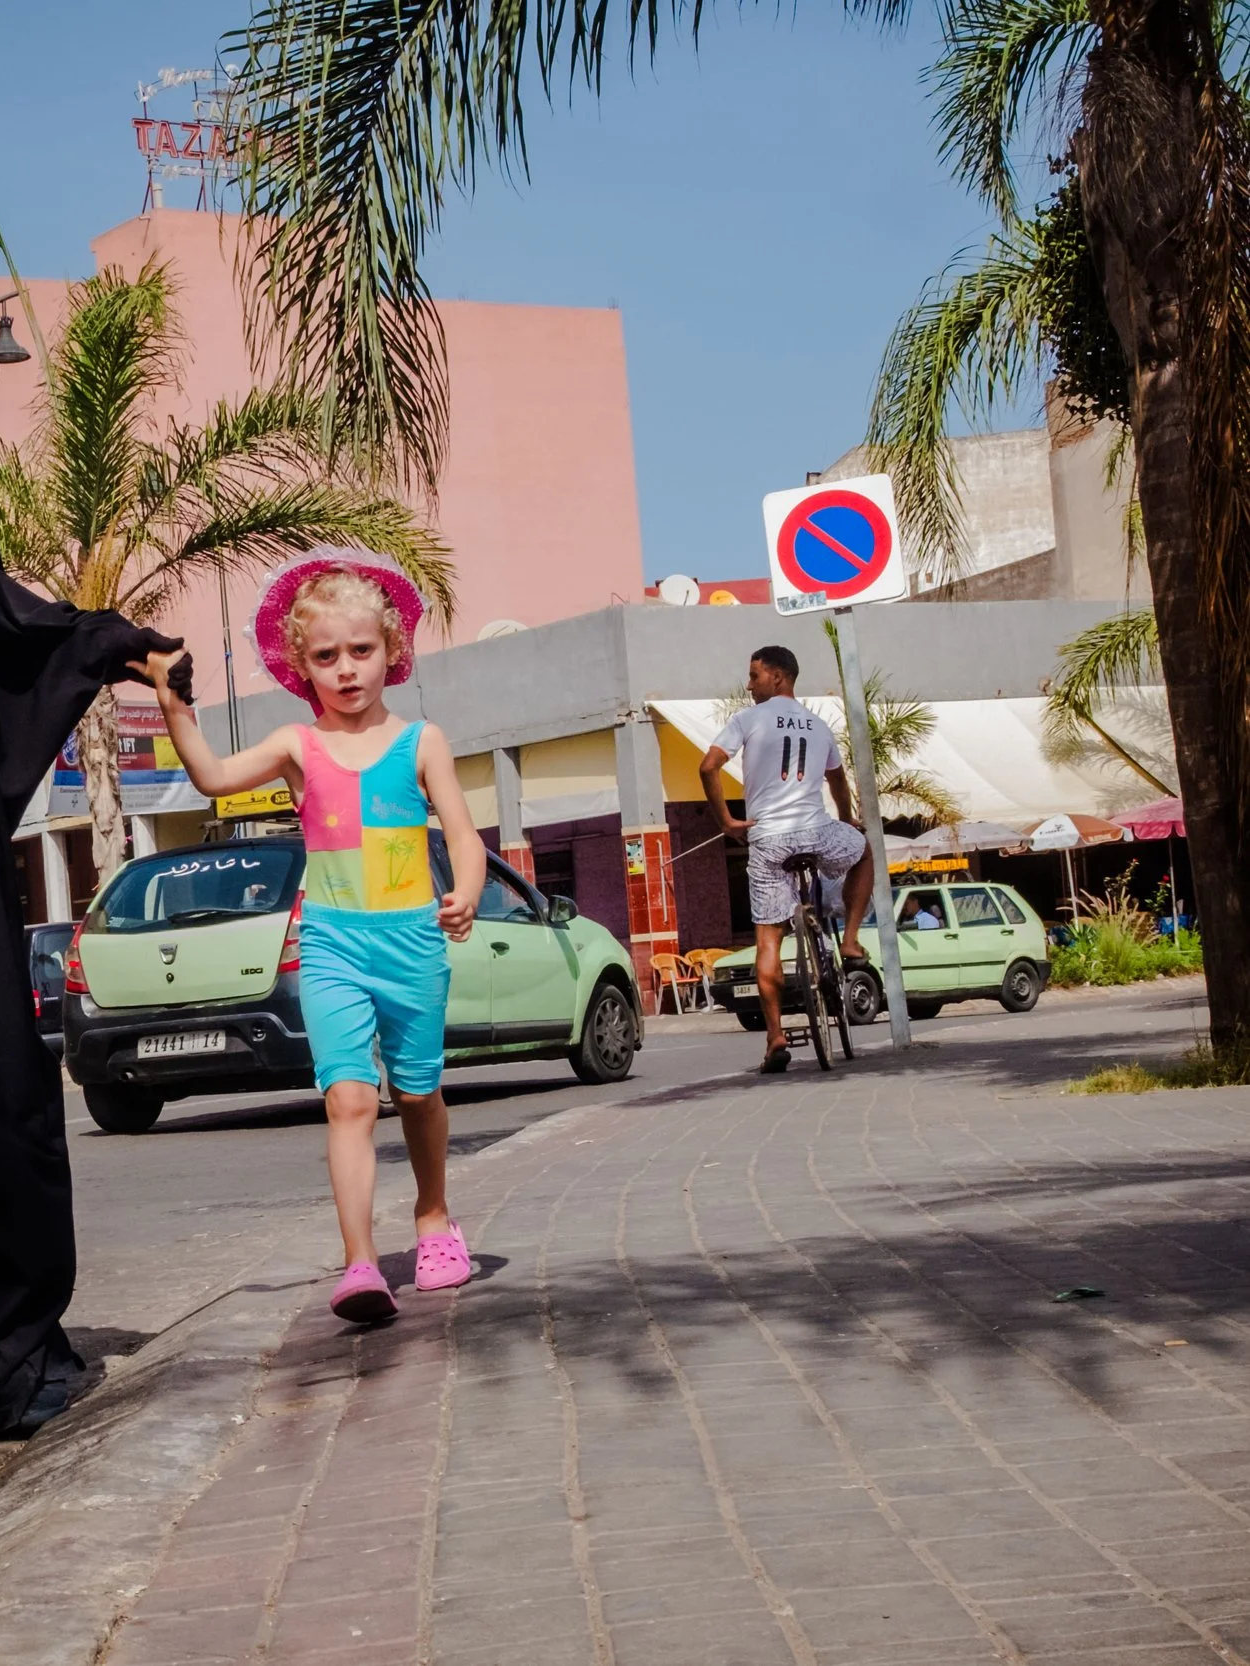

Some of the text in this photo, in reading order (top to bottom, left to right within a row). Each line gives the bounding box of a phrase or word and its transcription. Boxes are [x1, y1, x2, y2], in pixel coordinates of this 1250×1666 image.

[776, 716, 814, 731] BALE
[781, 735, 808, 782] 11
[144, 1035, 185, 1054] 21441
[203, 1032, 220, 1048] 14
